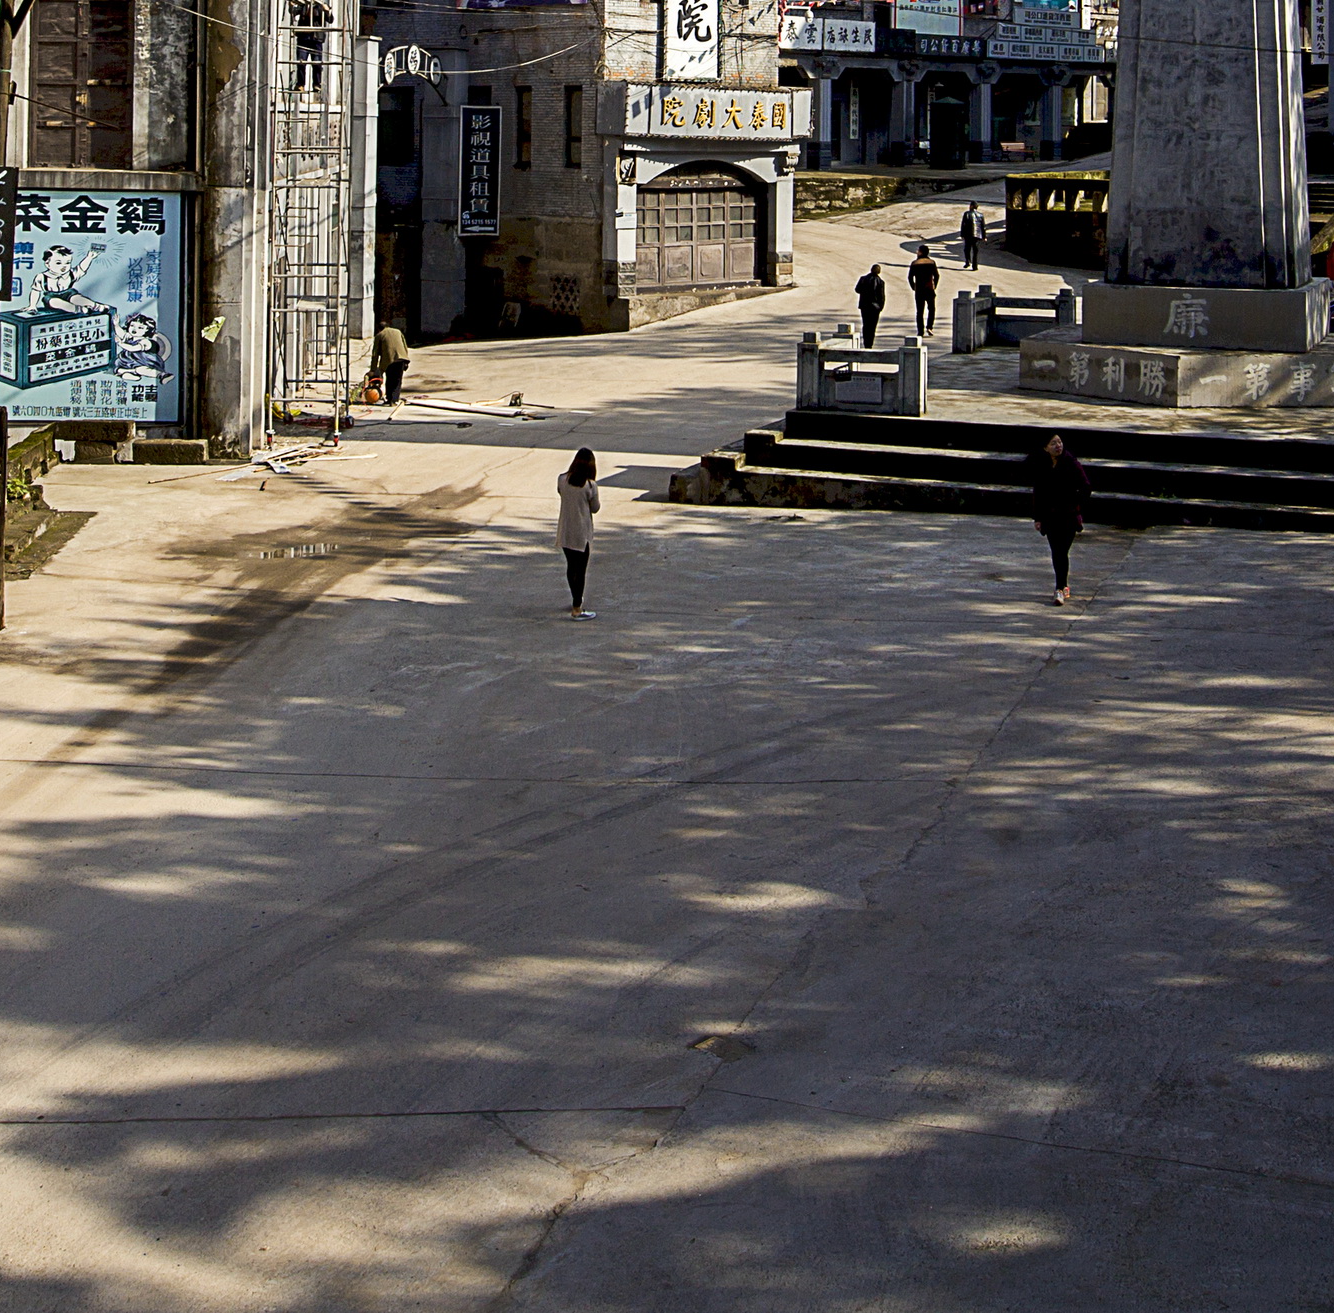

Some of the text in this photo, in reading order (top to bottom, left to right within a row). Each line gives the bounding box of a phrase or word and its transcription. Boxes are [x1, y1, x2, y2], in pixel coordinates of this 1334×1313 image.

[661, 96, 787, 131] 國泰大劇院
[469, 114, 492, 214] 影視道具租賃
